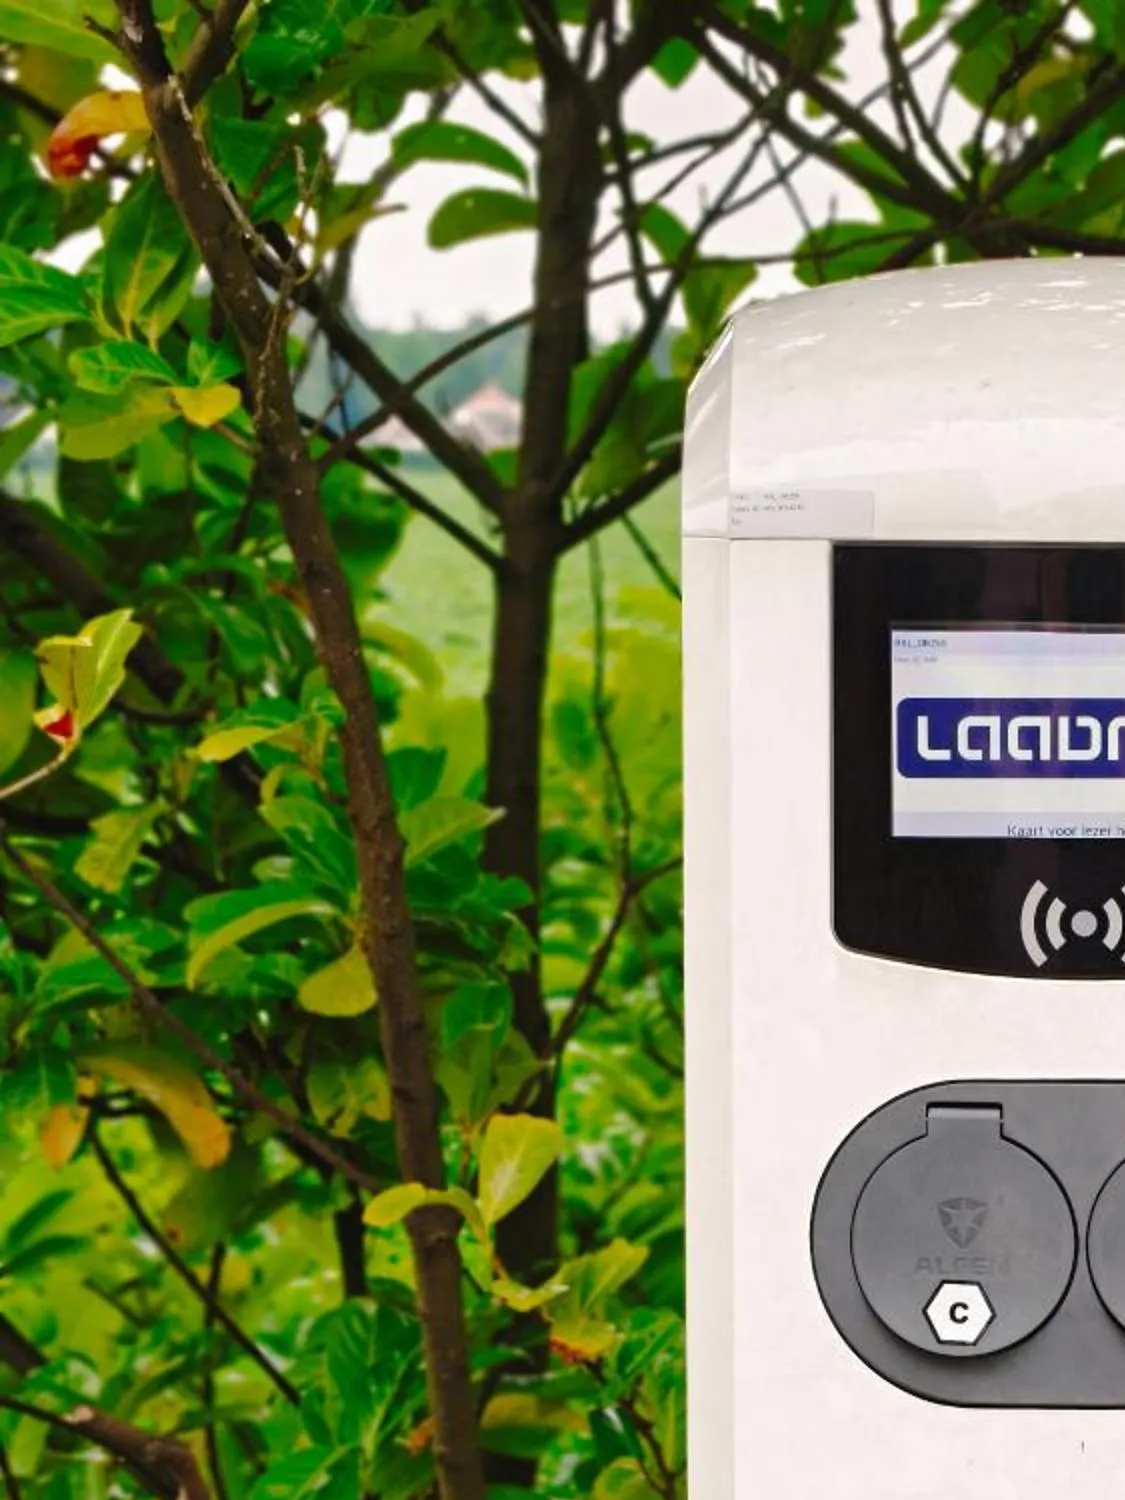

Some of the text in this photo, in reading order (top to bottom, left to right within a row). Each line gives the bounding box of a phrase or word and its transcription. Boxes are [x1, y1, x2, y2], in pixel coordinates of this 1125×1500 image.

[1007, 824, 1043, 838] Kaart
[1048, 827, 1077, 837] voor
[1081, 824, 1111, 837] lezer
[914, 1256, 1011, 1275] ALFEN
[949, 1301, 969, 1324] C
